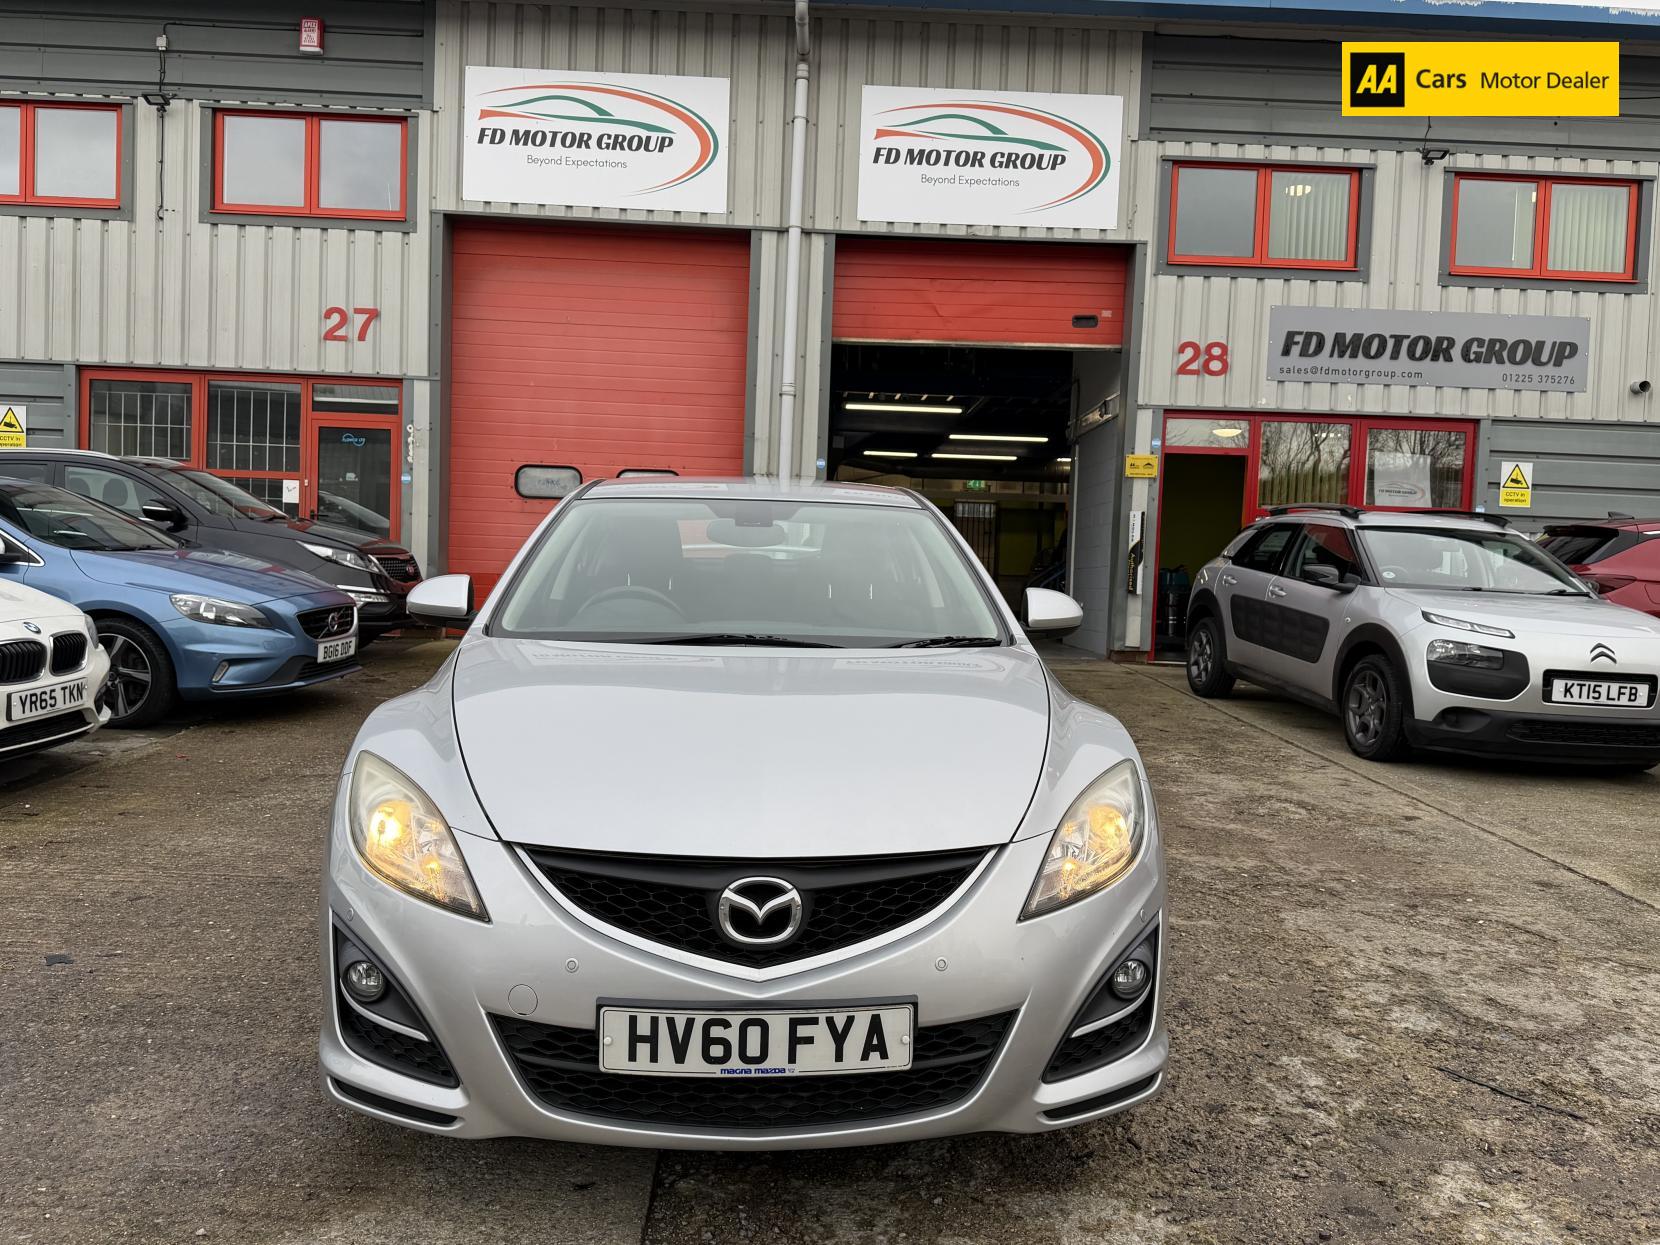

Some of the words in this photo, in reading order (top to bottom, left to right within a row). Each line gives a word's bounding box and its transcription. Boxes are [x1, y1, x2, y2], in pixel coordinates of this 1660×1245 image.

[477, 127, 506, 145] FD
[509, 129, 592, 149] MOTOR
[596, 133, 674, 153] GROUP
[527, 154, 563, 167] Beyond
[565, 156, 628, 169] Expectations
[873, 147, 901, 165] FD
[904, 149, 985, 168] MOTOR
[989, 151, 1067, 171] GROUP
[921, 174, 956, 187] Beyond
[958, 175, 1020, 188] Expectations
[323, 306, 379, 342] 27
[1176, 341, 1229, 376] 28
[1281, 330, 1325, 358] FD
[1329, 332, 1456, 362] MOTOR
[1460, 337, 1579, 367] GROUP
[1279, 365, 1423, 379] sales@fdmotorgroup.com
[1502, 373, 1534, 384] 01225
[1537, 374, 1576, 385] 375276
[19, 689, 57, 714] YR65
[61, 681, 84, 705] TKN
[1563, 682, 1602, 700] KT15
[1606, 684, 1638, 702] LFB
[628, 1015, 769, 1065] HV60
[787, 1014, 889, 1064] FYA
